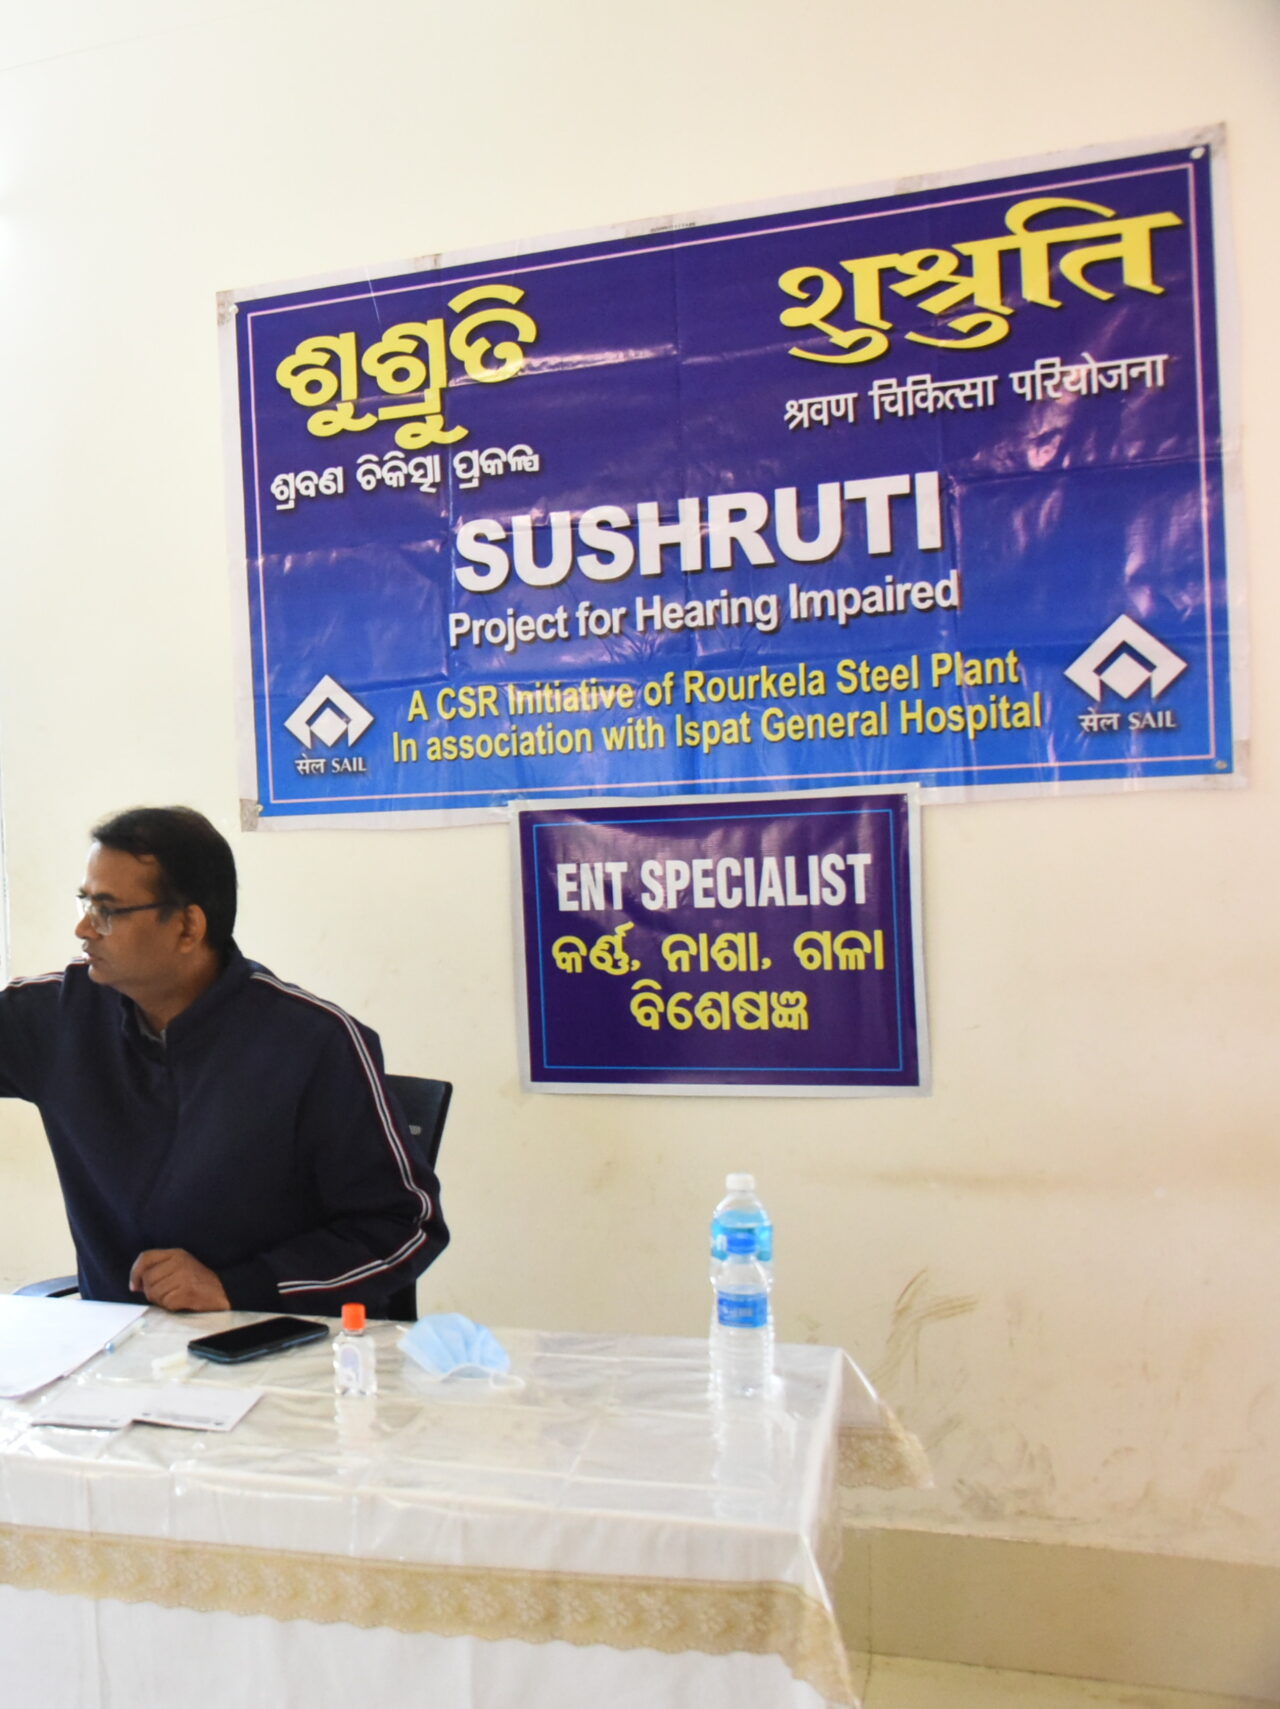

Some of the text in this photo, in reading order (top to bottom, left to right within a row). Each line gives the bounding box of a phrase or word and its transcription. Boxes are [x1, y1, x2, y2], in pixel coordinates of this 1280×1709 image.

[778, 197, 1184, 364] शुश्रुति
[784, 352, 1168, 429] श्रवण चिकित्सा परियोजना
[271, 467, 344, 510] ଶ୍ରବଣ
[454, 470, 944, 592] SUSHRUTI
[448, 570, 959, 651] Project for Hearing Impaired
[408, 649, 1020, 722] A CSR Initiative of Rourkela Steel Plant
[393, 691, 1043, 763] In association with Ispat General Hospital
[1078, 706, 1177, 732] सेल SAIL
[295, 753, 368, 775] सेल SAIL
[556, 853, 873, 912] ENT SPECIALIST
[793, 929, 886, 971] ଗଳା
[630, 978, 810, 1031] ବିଶେଷଜ୍ଞ
